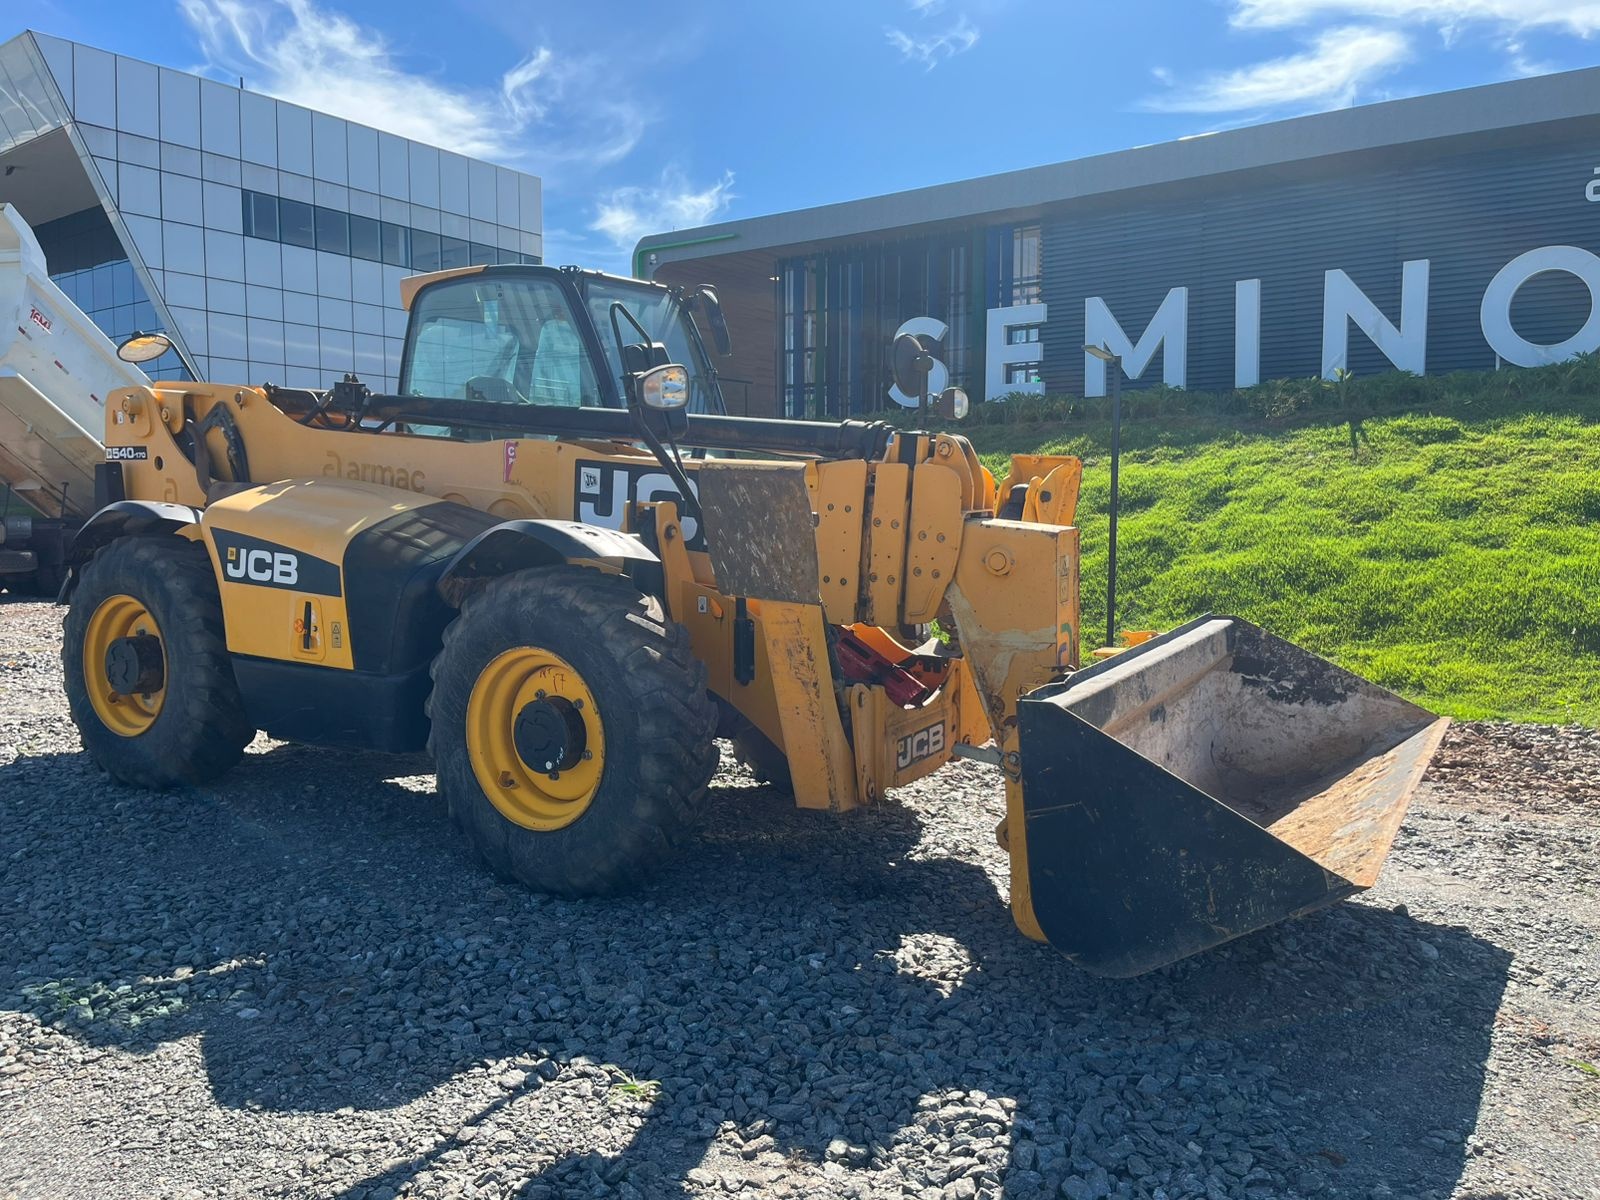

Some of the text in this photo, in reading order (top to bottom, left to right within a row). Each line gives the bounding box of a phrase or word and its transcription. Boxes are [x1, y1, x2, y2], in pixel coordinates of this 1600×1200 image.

[347, 461, 426, 493] armac
[226, 547, 299, 585] JCB
[898, 723, 944, 768] JCB
